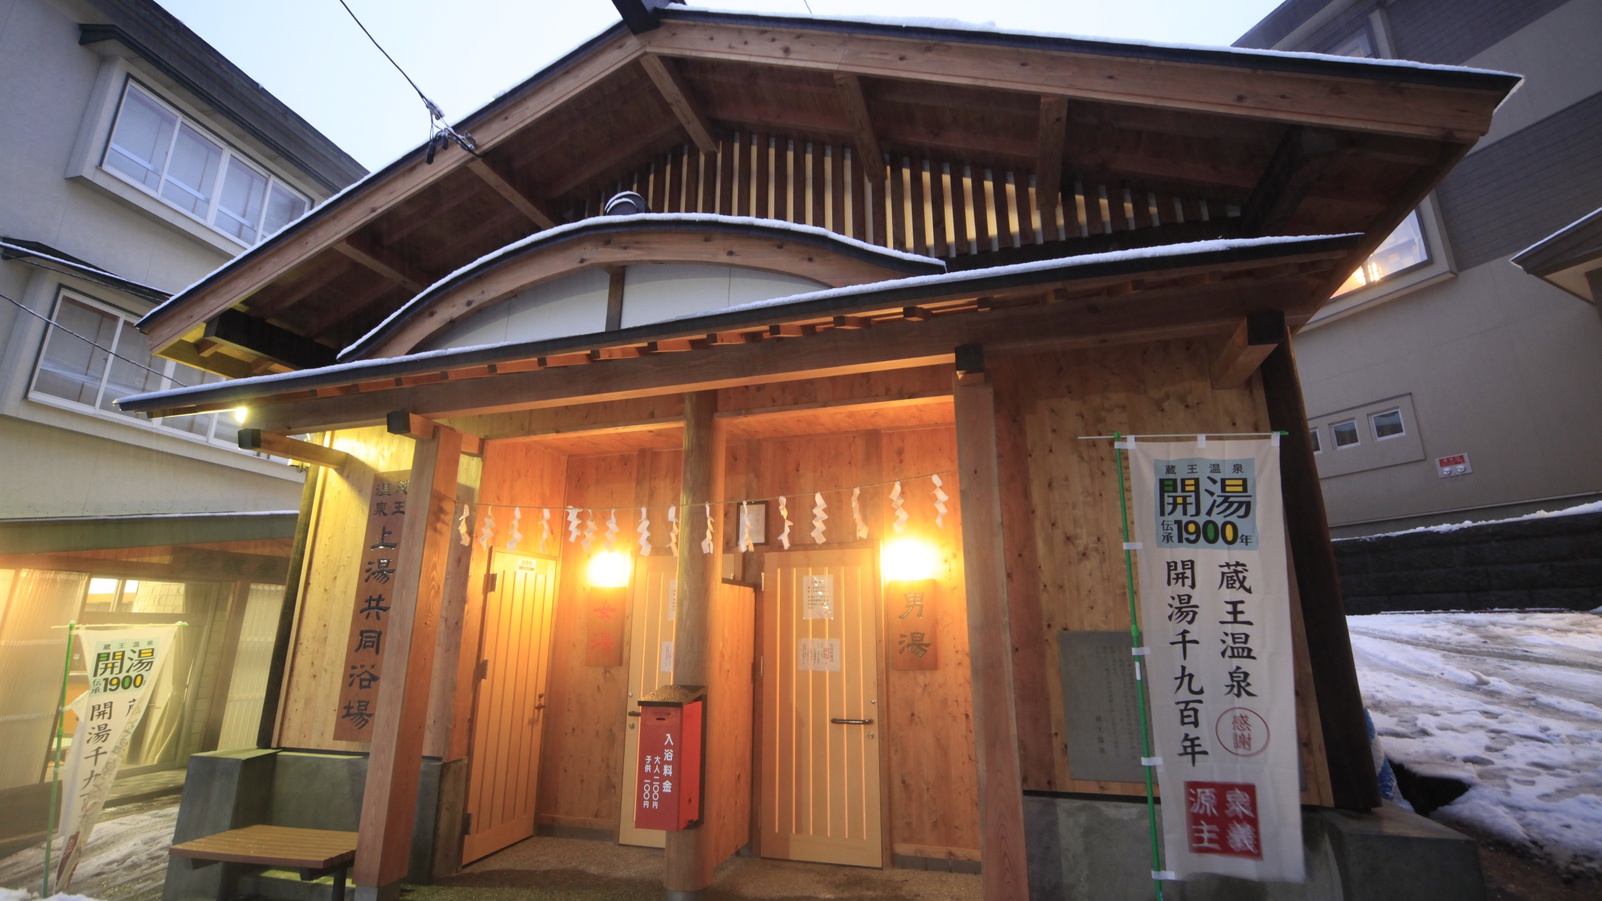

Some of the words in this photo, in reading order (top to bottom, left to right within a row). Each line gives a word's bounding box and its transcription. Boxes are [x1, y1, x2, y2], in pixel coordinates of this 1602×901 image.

[1165, 463, 1244, 475] 蔵王温泉
[1158, 475, 1253, 519] 開湯
[1161, 520, 1174, 544] 伝承
[342, 525, 398, 730] 上湯共同浴場
[591, 602, 618, 655] 女湯
[898, 592, 931, 658] 男湯
[1217, 562, 1259, 698] 蔵王温泉
[93, 648, 155, 677] 開湯
[103, 674, 146, 693] 1900
[1166, 559, 1211, 767] 開湯千九百年
[662, 733, 674, 793] 入浴料金
